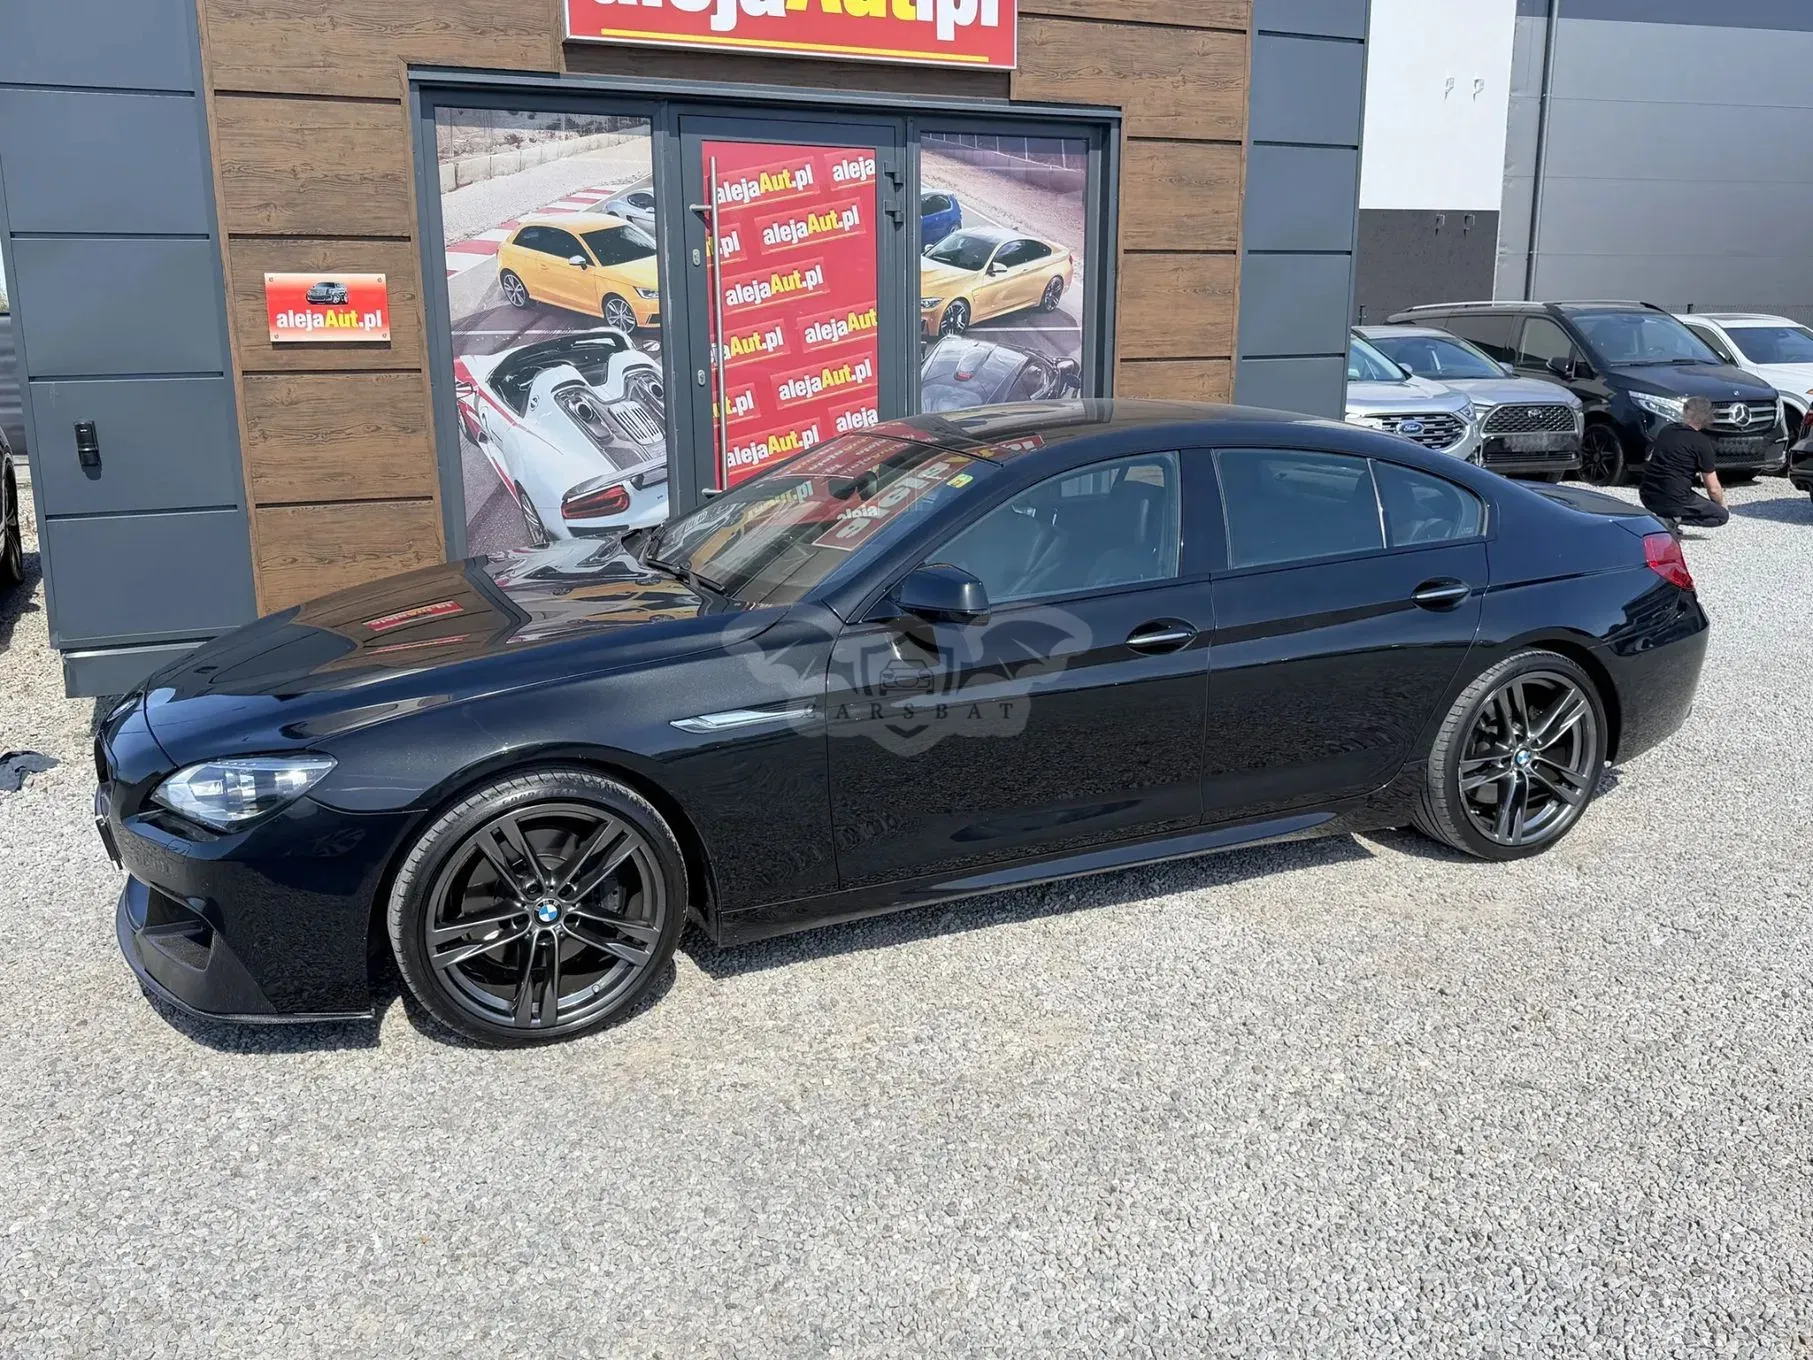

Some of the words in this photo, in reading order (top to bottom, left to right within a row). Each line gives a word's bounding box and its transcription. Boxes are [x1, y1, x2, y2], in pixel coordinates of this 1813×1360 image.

[762, 205, 860, 245] alejaAut.pl
[725, 264, 824, 306] alejaAut.pl
[276, 309, 382, 332] alejaAut.pl
[778, 358, 872, 401] alejaAut.pl
